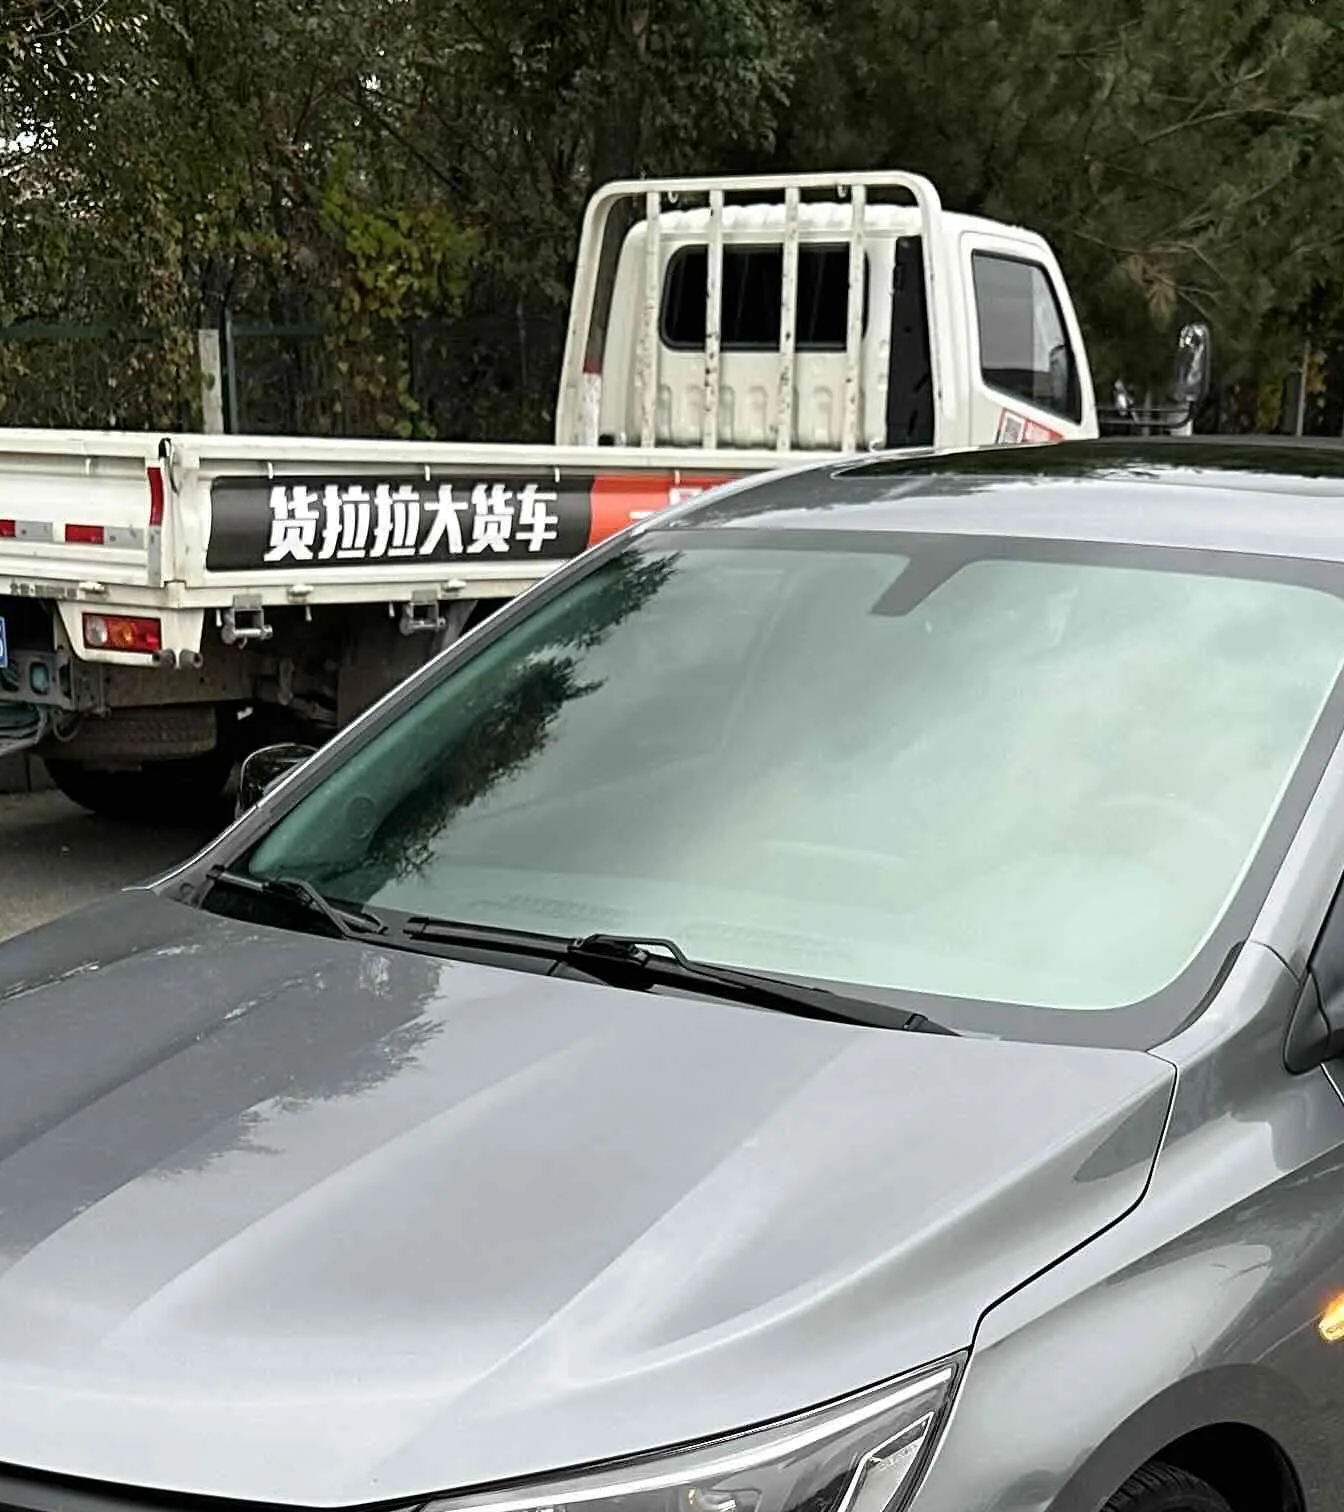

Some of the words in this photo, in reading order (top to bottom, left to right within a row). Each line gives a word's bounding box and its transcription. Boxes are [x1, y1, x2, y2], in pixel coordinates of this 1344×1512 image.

[264, 483, 558, 562] 货拉拉大货车
